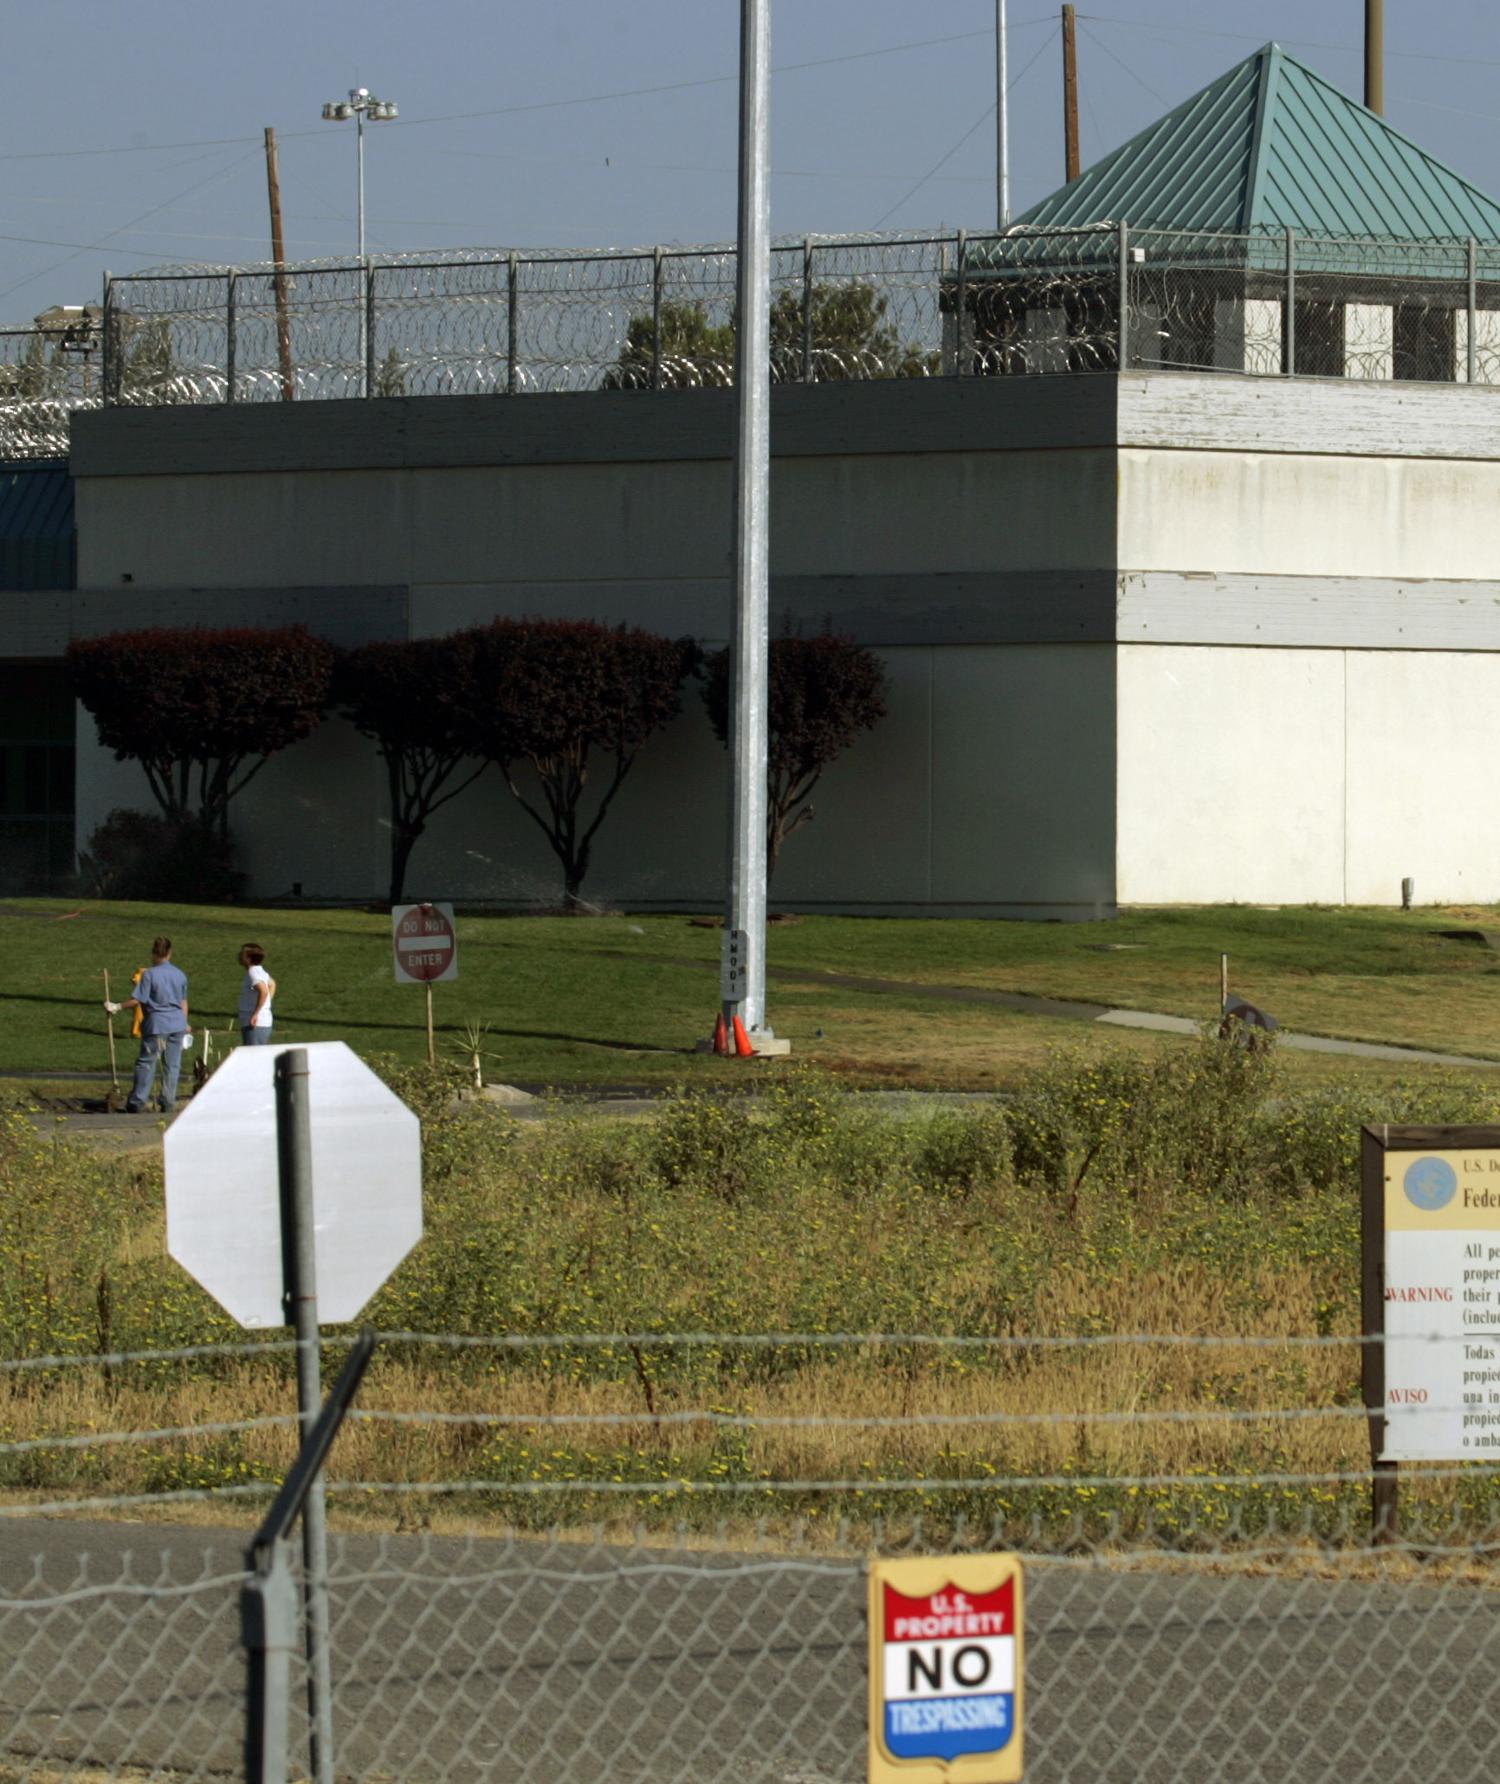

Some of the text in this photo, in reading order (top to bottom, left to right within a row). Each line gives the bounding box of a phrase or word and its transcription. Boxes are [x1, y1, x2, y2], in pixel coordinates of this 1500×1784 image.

[403, 919, 446, 933] DO NOT
[408, 953, 443, 968] ENTER
[1463, 1159, 1484, 1173] U.S.
[1463, 1243, 1482, 1258] All
[1385, 1287, 1453, 1303] WARNING
[1462, 1287, 1491, 1302] their
[1463, 1344, 1495, 1360] Todas
[1387, 1388, 1429, 1404] AVISO
[1462, 1392, 1483, 1404] una
[1462, 1437, 1470, 1447] o
[930, 1592, 973, 1615] U.S.
[894, 1612, 1005, 1637] PROPERTY
[907, 1645, 992, 1692] NO
[889, 1696, 1007, 1735] TRESPASSING
